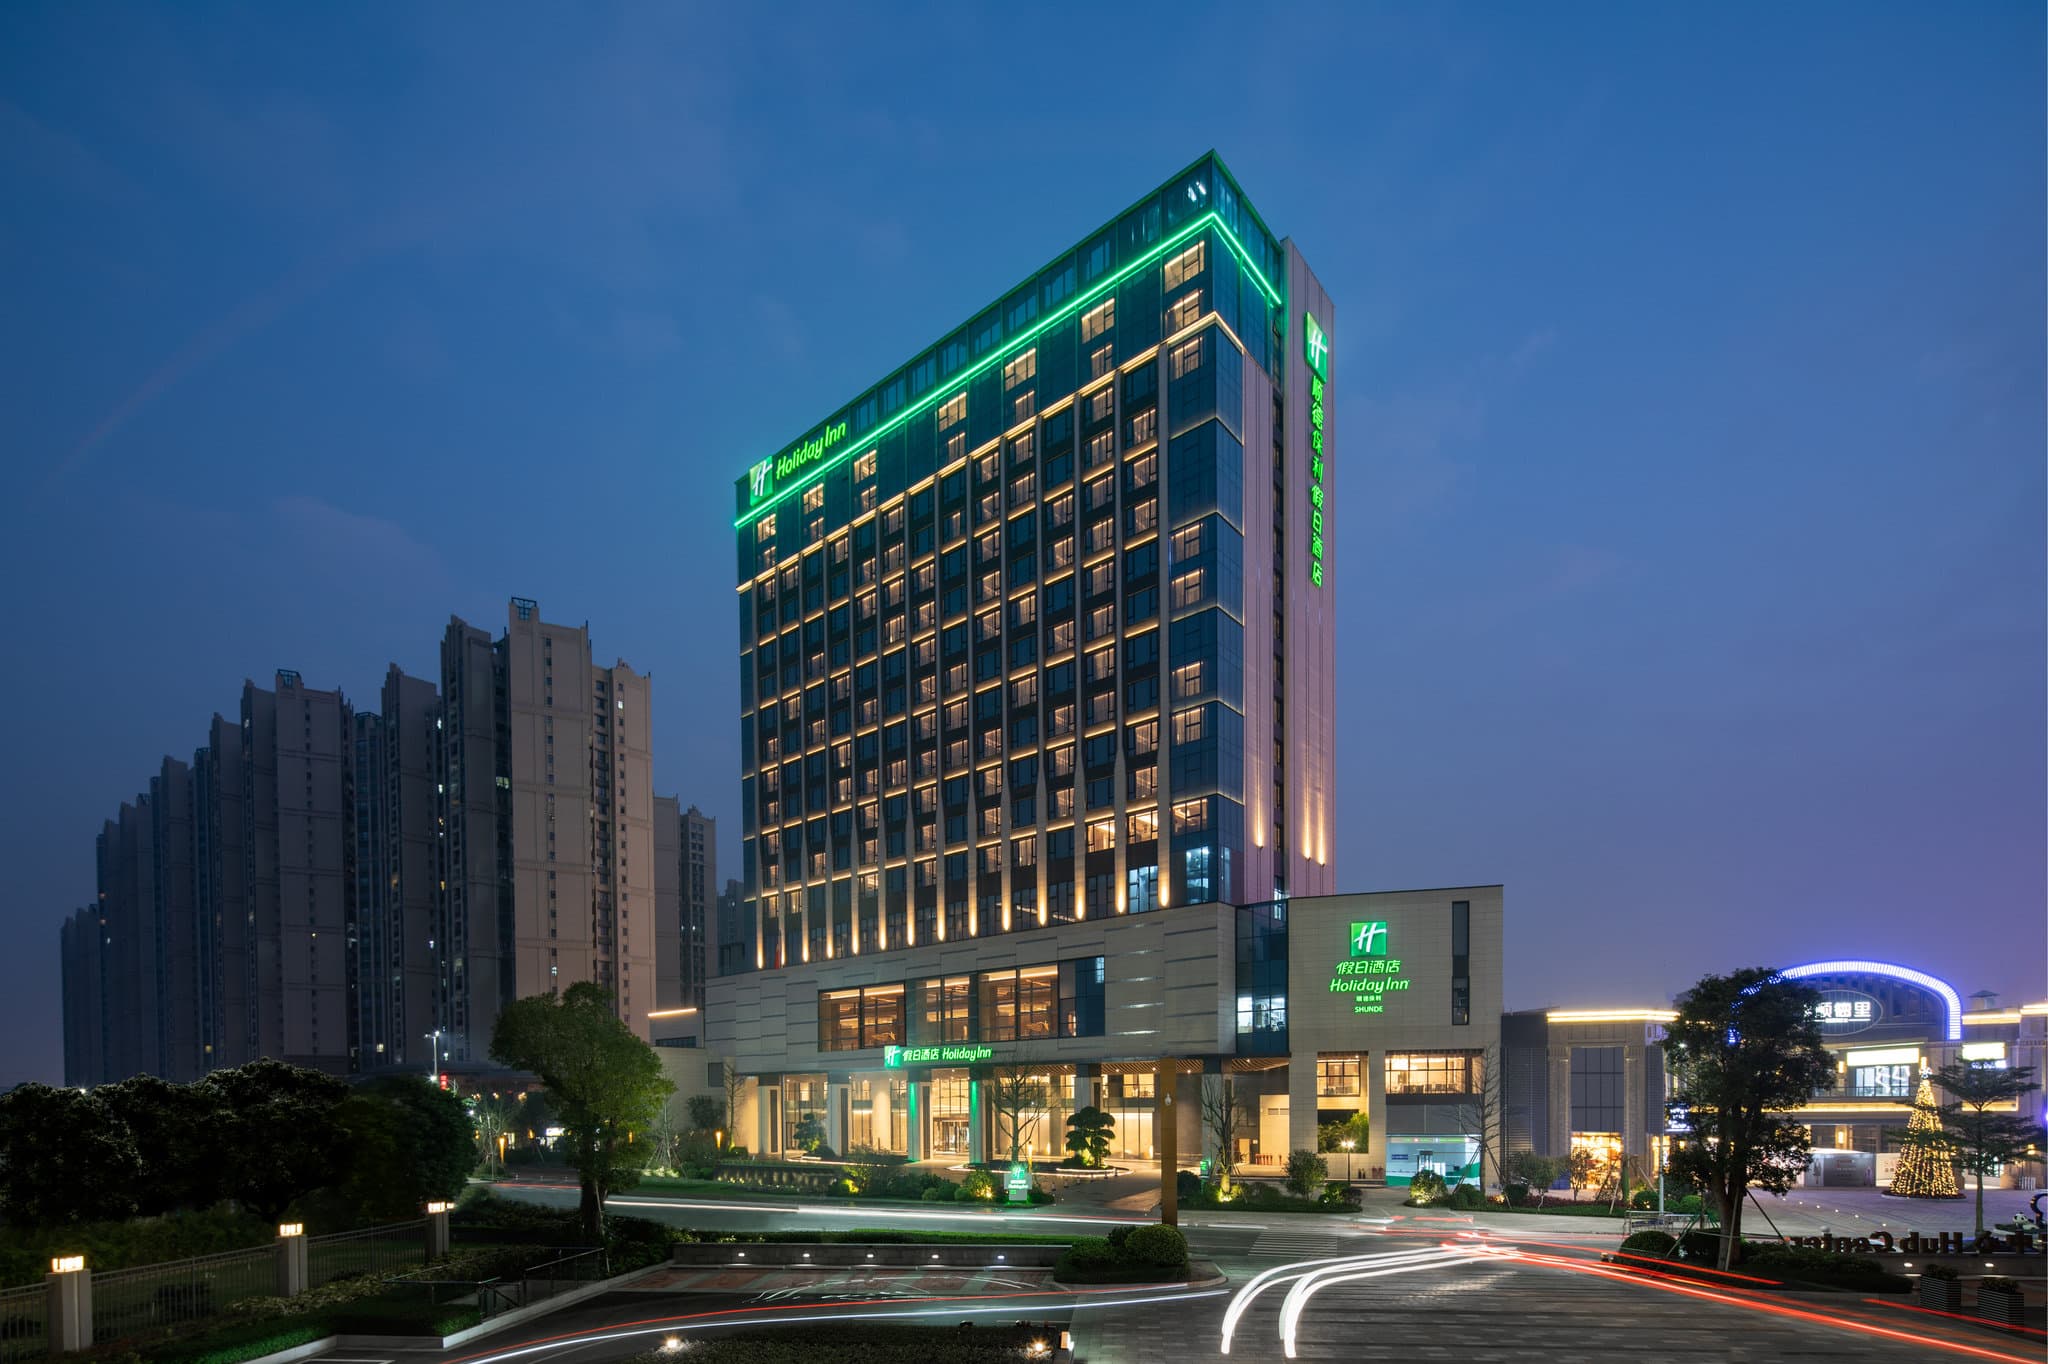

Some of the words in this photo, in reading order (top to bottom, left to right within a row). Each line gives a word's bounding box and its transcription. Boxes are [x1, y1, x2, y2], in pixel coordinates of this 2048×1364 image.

[776, 437, 823, 480] Holiday
[825, 422, 846, 447] Inn
[1336, 960, 1401, 975] 假日酒店
[1330, 977, 1384, 994] Holiday
[1386, 976, 1409, 990] Inn
[1354, 1005, 1384, 1013] SHUNDE
[1803, 1001, 1872, 1018] 顺德里
[903, 1048, 939, 1061] 假日酒店
[942, 1047, 976, 1062] Holiday
[977, 1045, 992, 1059] Inn
